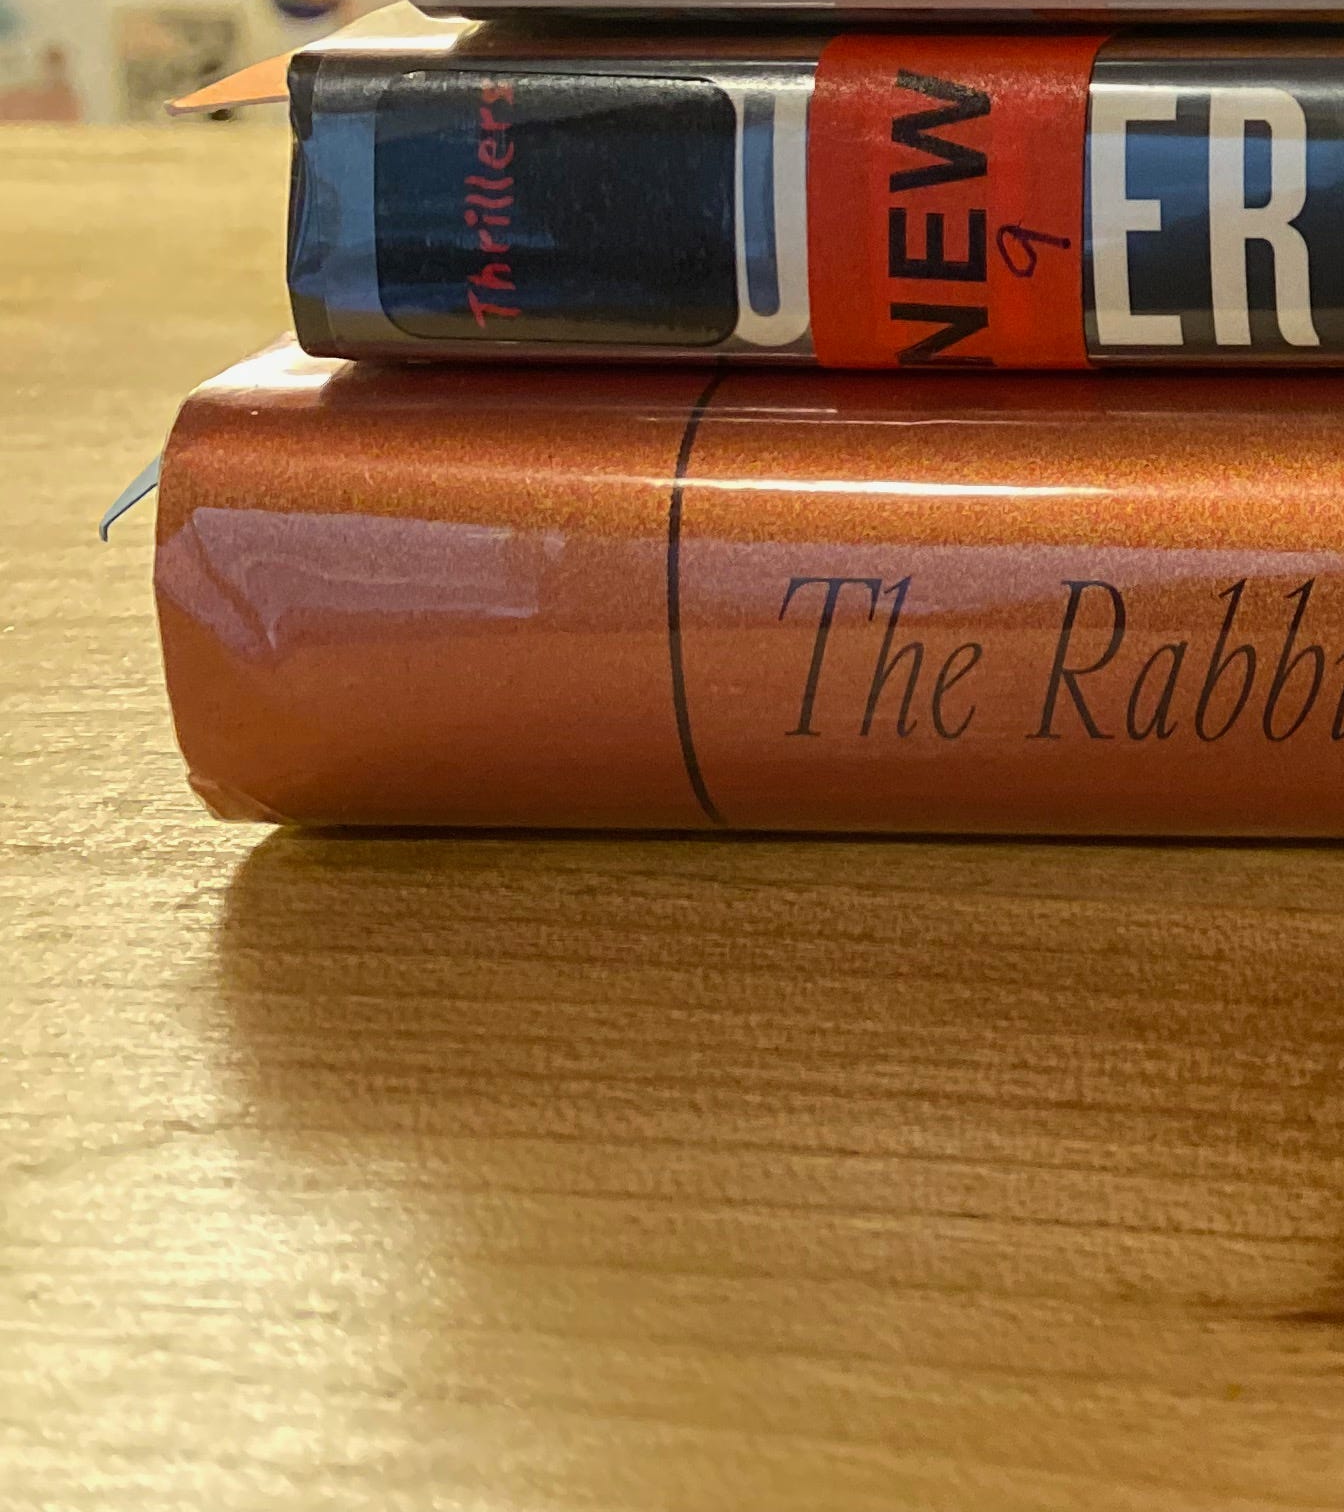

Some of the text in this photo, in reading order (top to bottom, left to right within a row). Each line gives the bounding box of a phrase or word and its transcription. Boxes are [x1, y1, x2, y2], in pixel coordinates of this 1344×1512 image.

[463, 78, 522, 328] Thrillers
[887, 68, 996, 365] NEW
[777, 573, 984, 740] The
